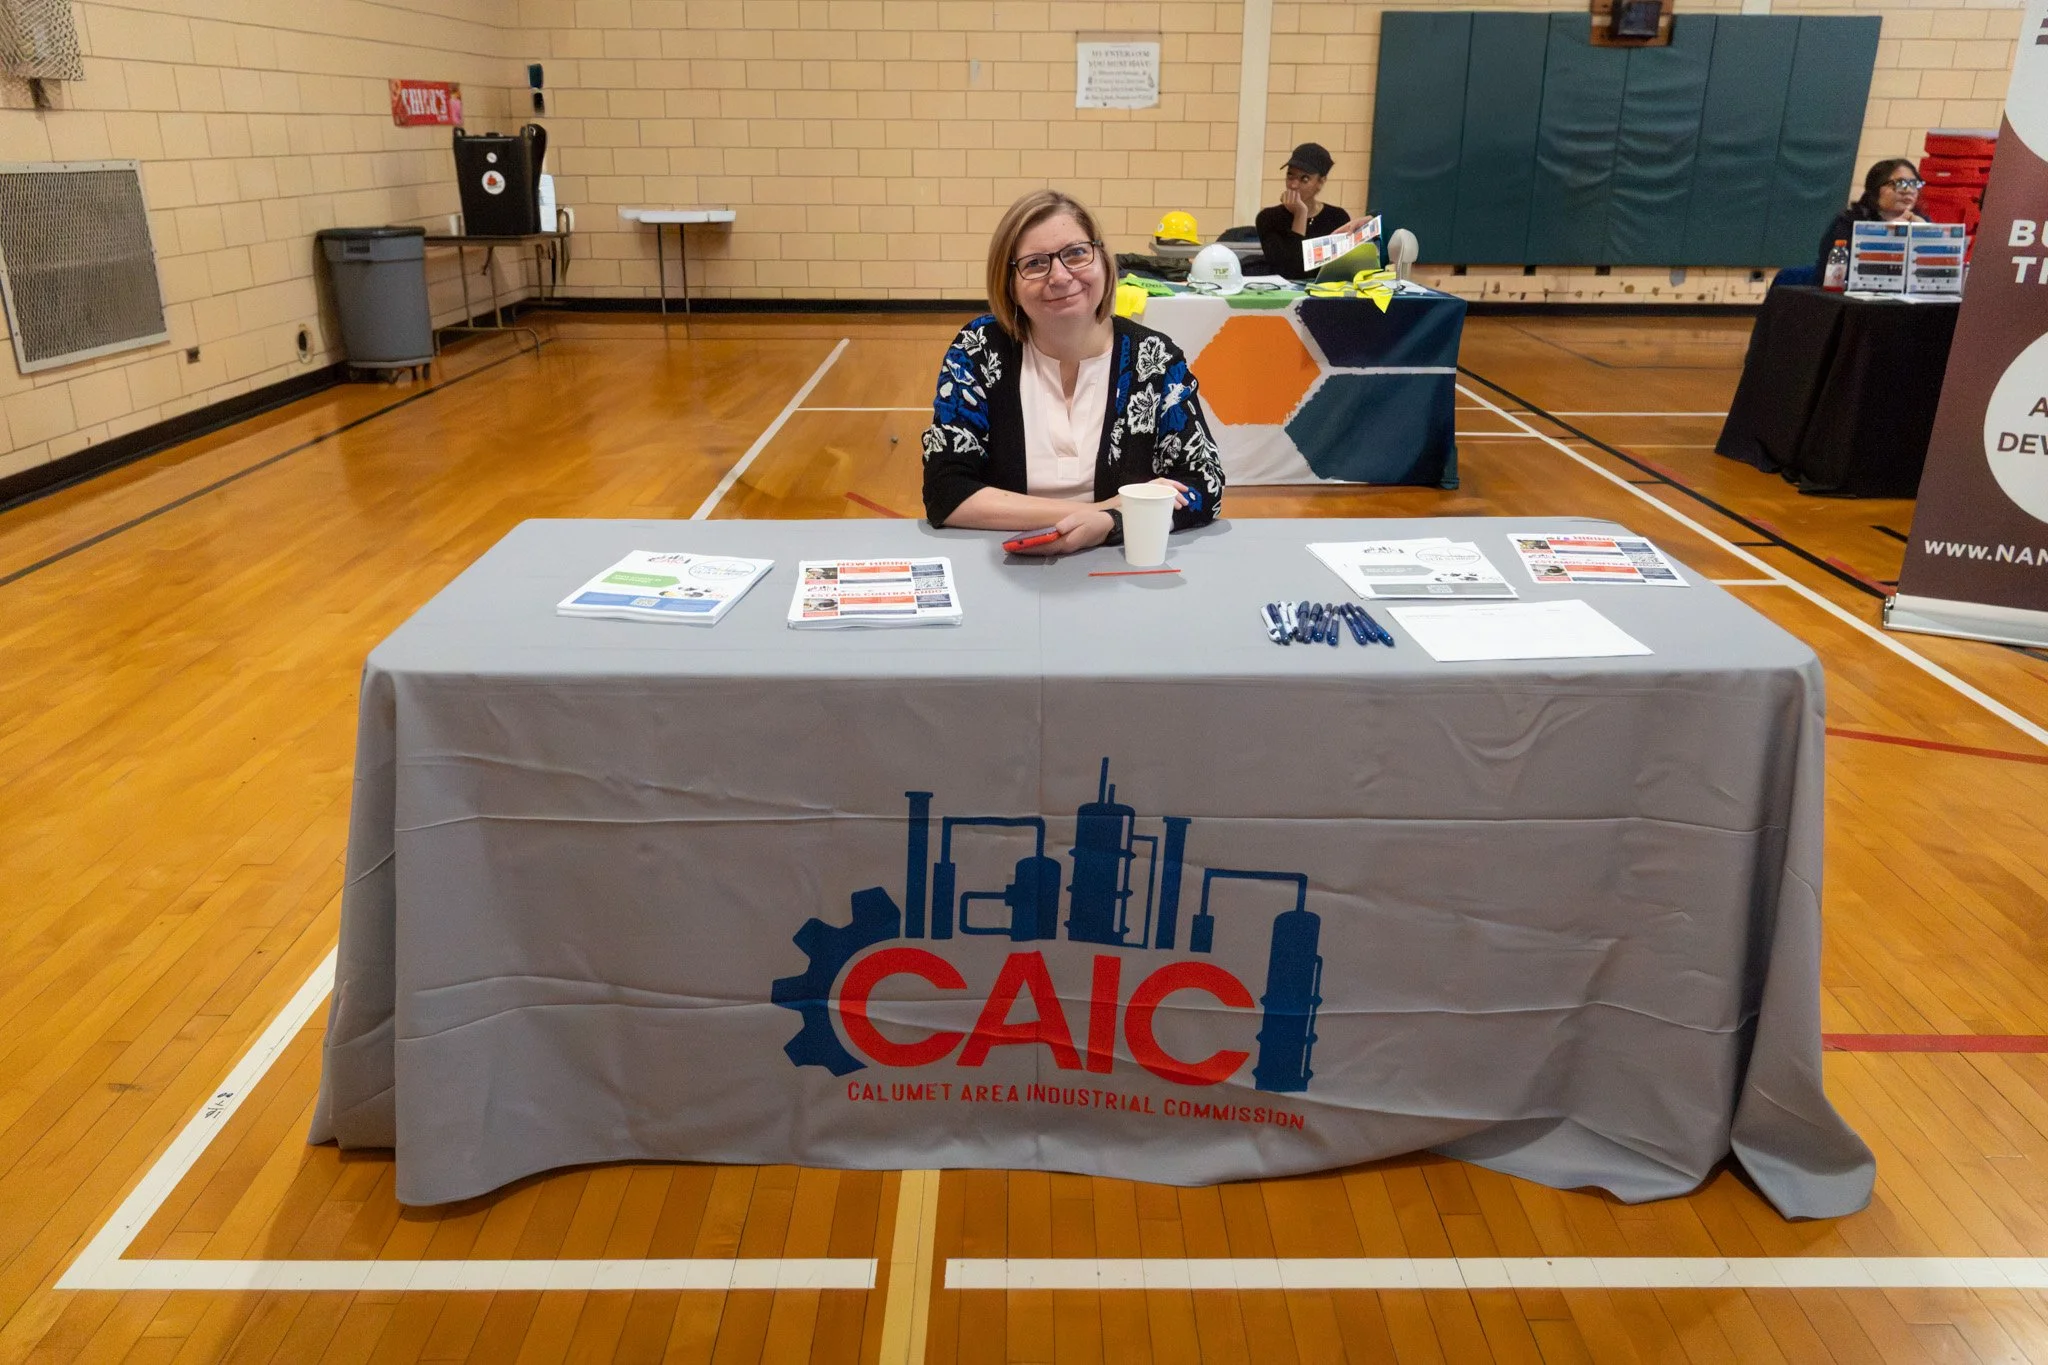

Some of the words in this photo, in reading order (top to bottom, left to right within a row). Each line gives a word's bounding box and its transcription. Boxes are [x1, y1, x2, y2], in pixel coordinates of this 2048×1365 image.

[839, 947, 1255, 1086] CAIC
[848, 1080, 952, 1102] CALUMET
[960, 1084, 1019, 1102] AREA
[1026, 1083, 1155, 1114] INDUSTRIAL
[1163, 1098, 1305, 1131] COMMISSION
